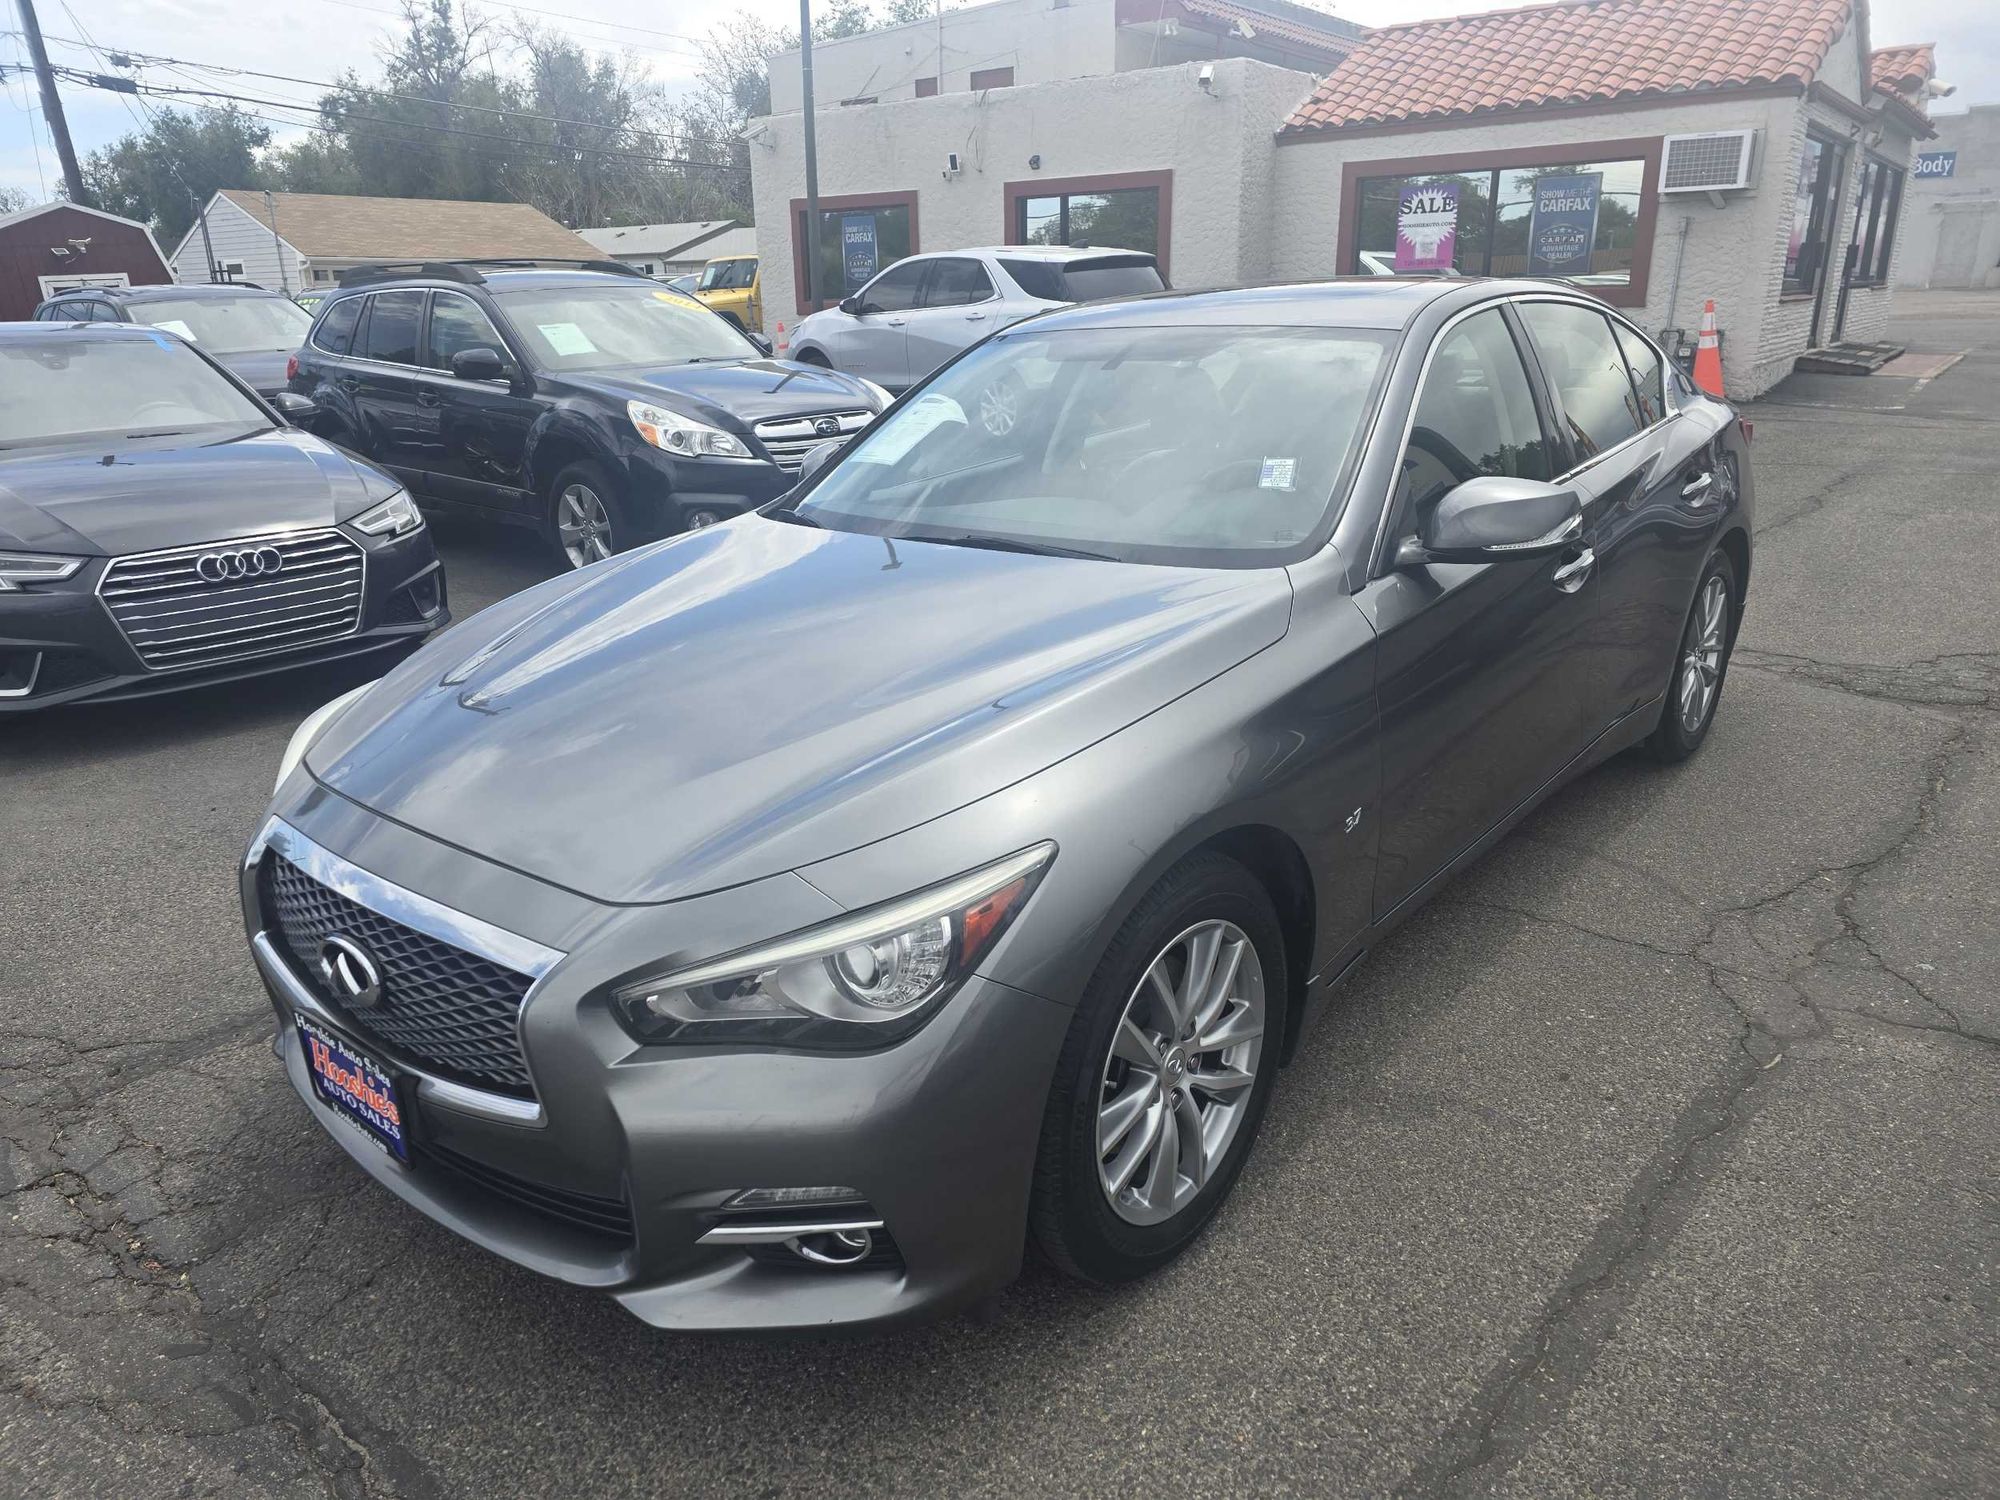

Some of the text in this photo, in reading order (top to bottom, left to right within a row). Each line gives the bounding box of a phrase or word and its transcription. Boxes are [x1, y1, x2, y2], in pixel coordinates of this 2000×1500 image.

[1540, 189, 1565, 199] SHOW
[1400, 196, 1455, 214] SALE
[1540, 197, 1591, 213] CARFAX
[845, 232, 873, 243] CARFAX
[338, 1041, 363, 1067] Auto
[310, 1037, 400, 1125] Hooshie's
[323, 1077, 401, 1140] AUTO SALES
